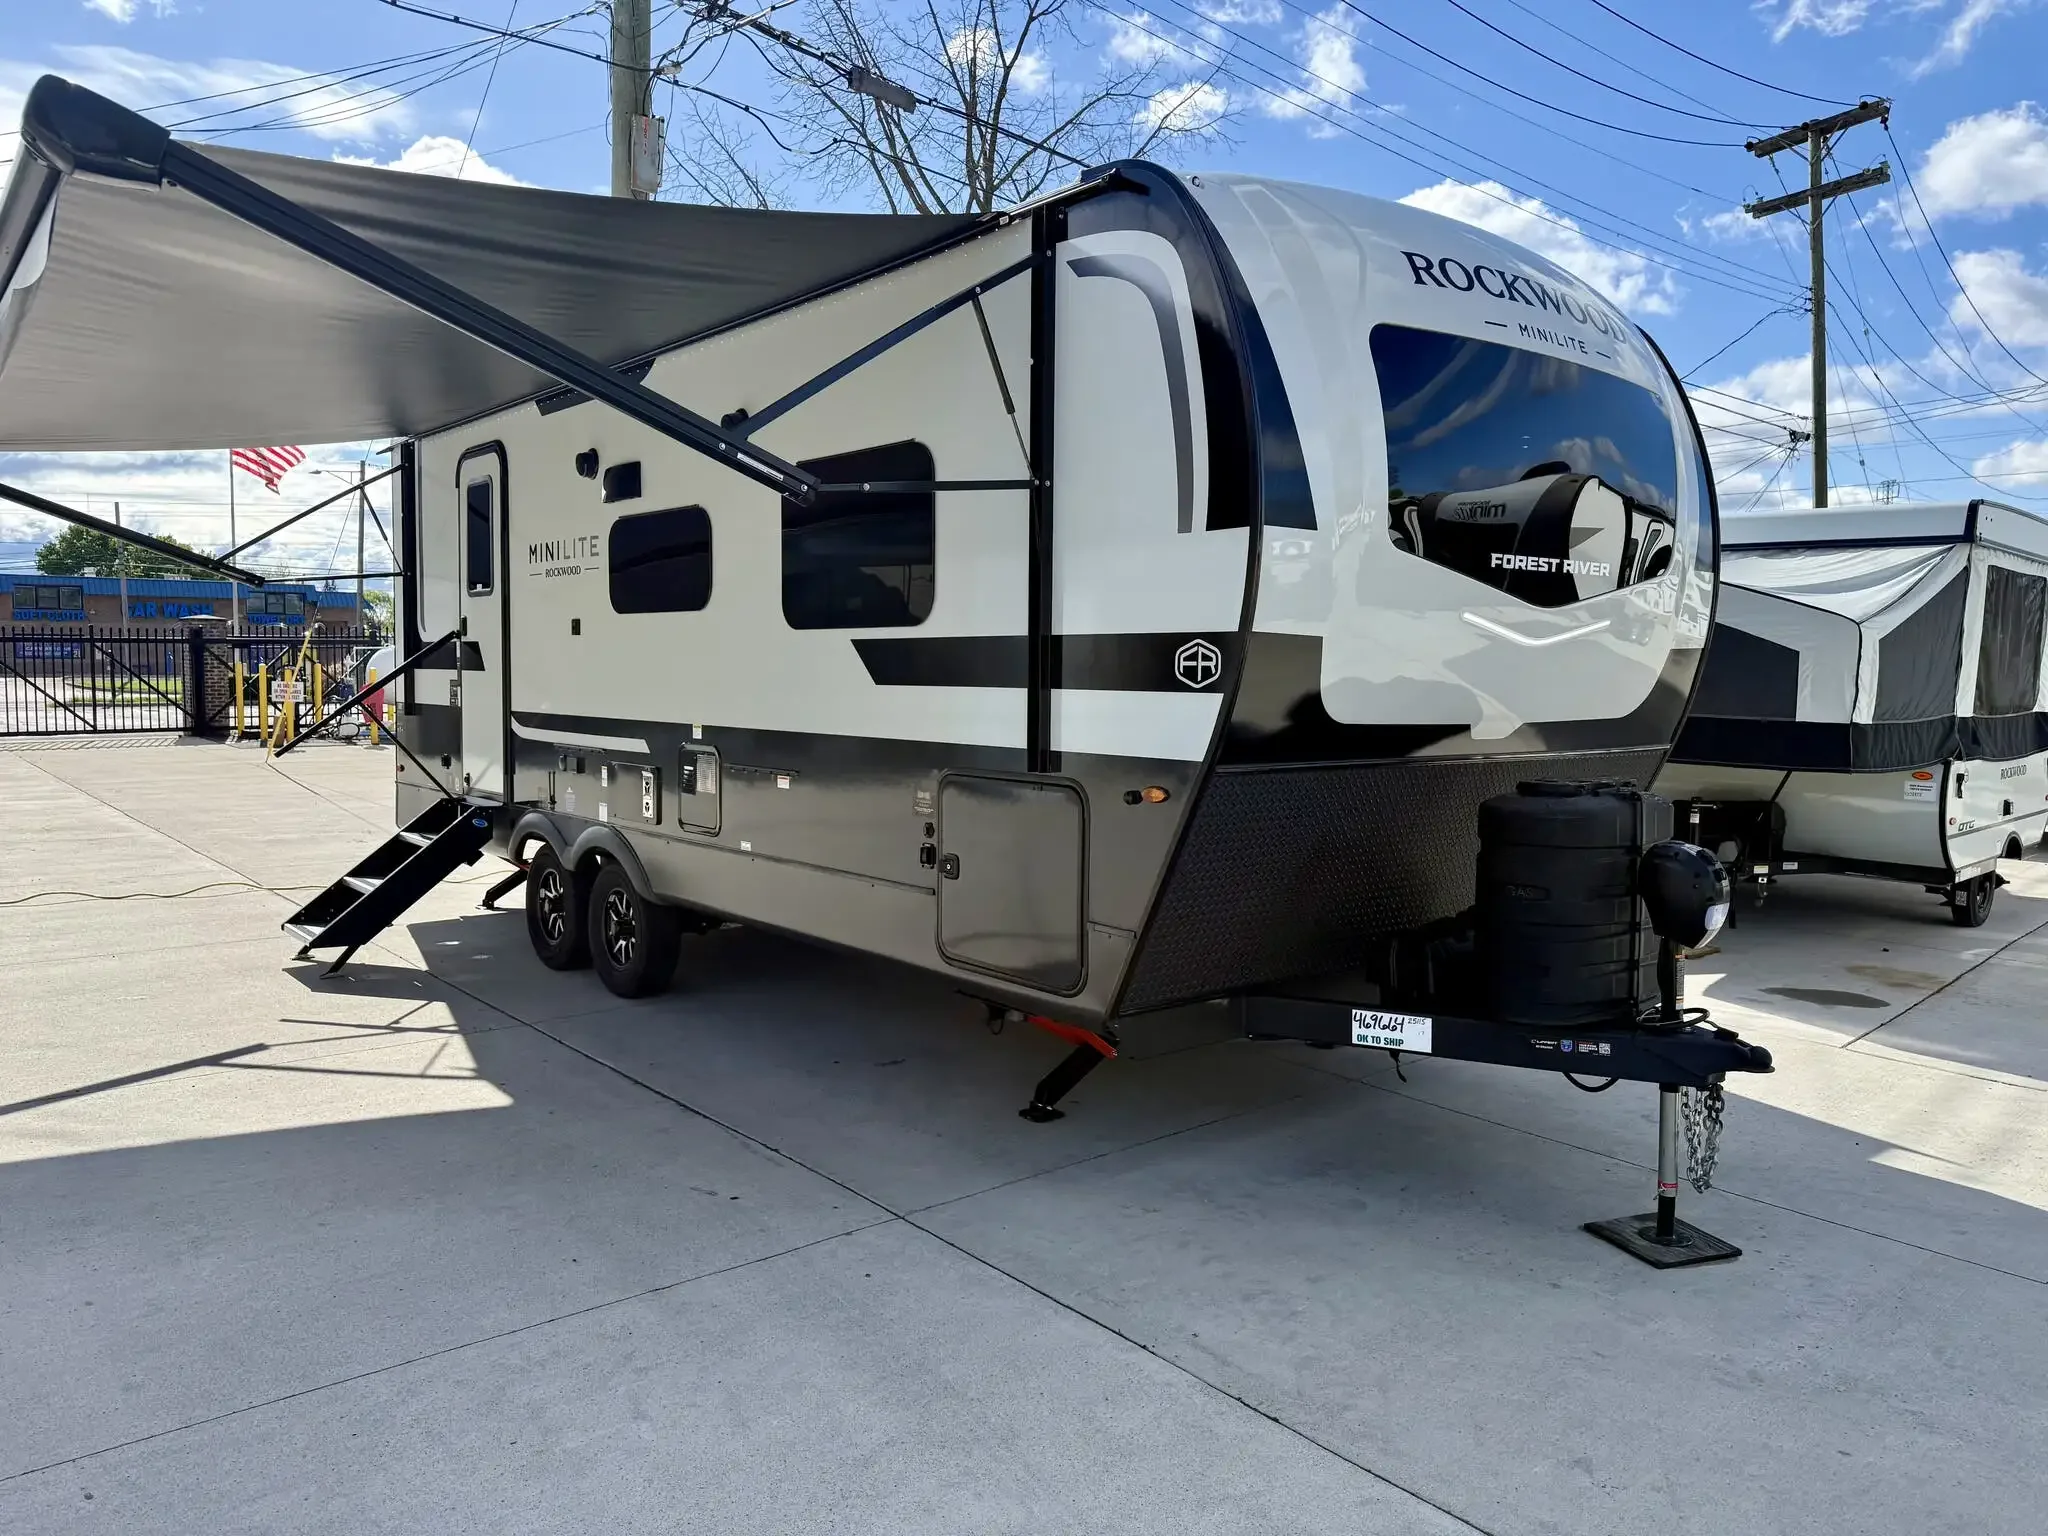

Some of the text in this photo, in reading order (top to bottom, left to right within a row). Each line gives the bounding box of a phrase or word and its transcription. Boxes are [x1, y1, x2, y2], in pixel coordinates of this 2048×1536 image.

[1400, 250, 1626, 344] ROCKWOOD
[1519, 323, 1588, 355] MINILITE
[529, 535, 600, 564] MINILITE
[545, 565, 582, 578] ROCKWOOD
[1491, 553, 1610, 577] FOREST RIVER
[163, 602, 214, 618] WASH
[2000, 765, 2027, 780] ROCKWOOD
[1957, 820, 1976, 832] OTG
[1353, 1011, 1405, 1033] 469664
[1357, 1033, 1404, 1047] OK TO SHIP
